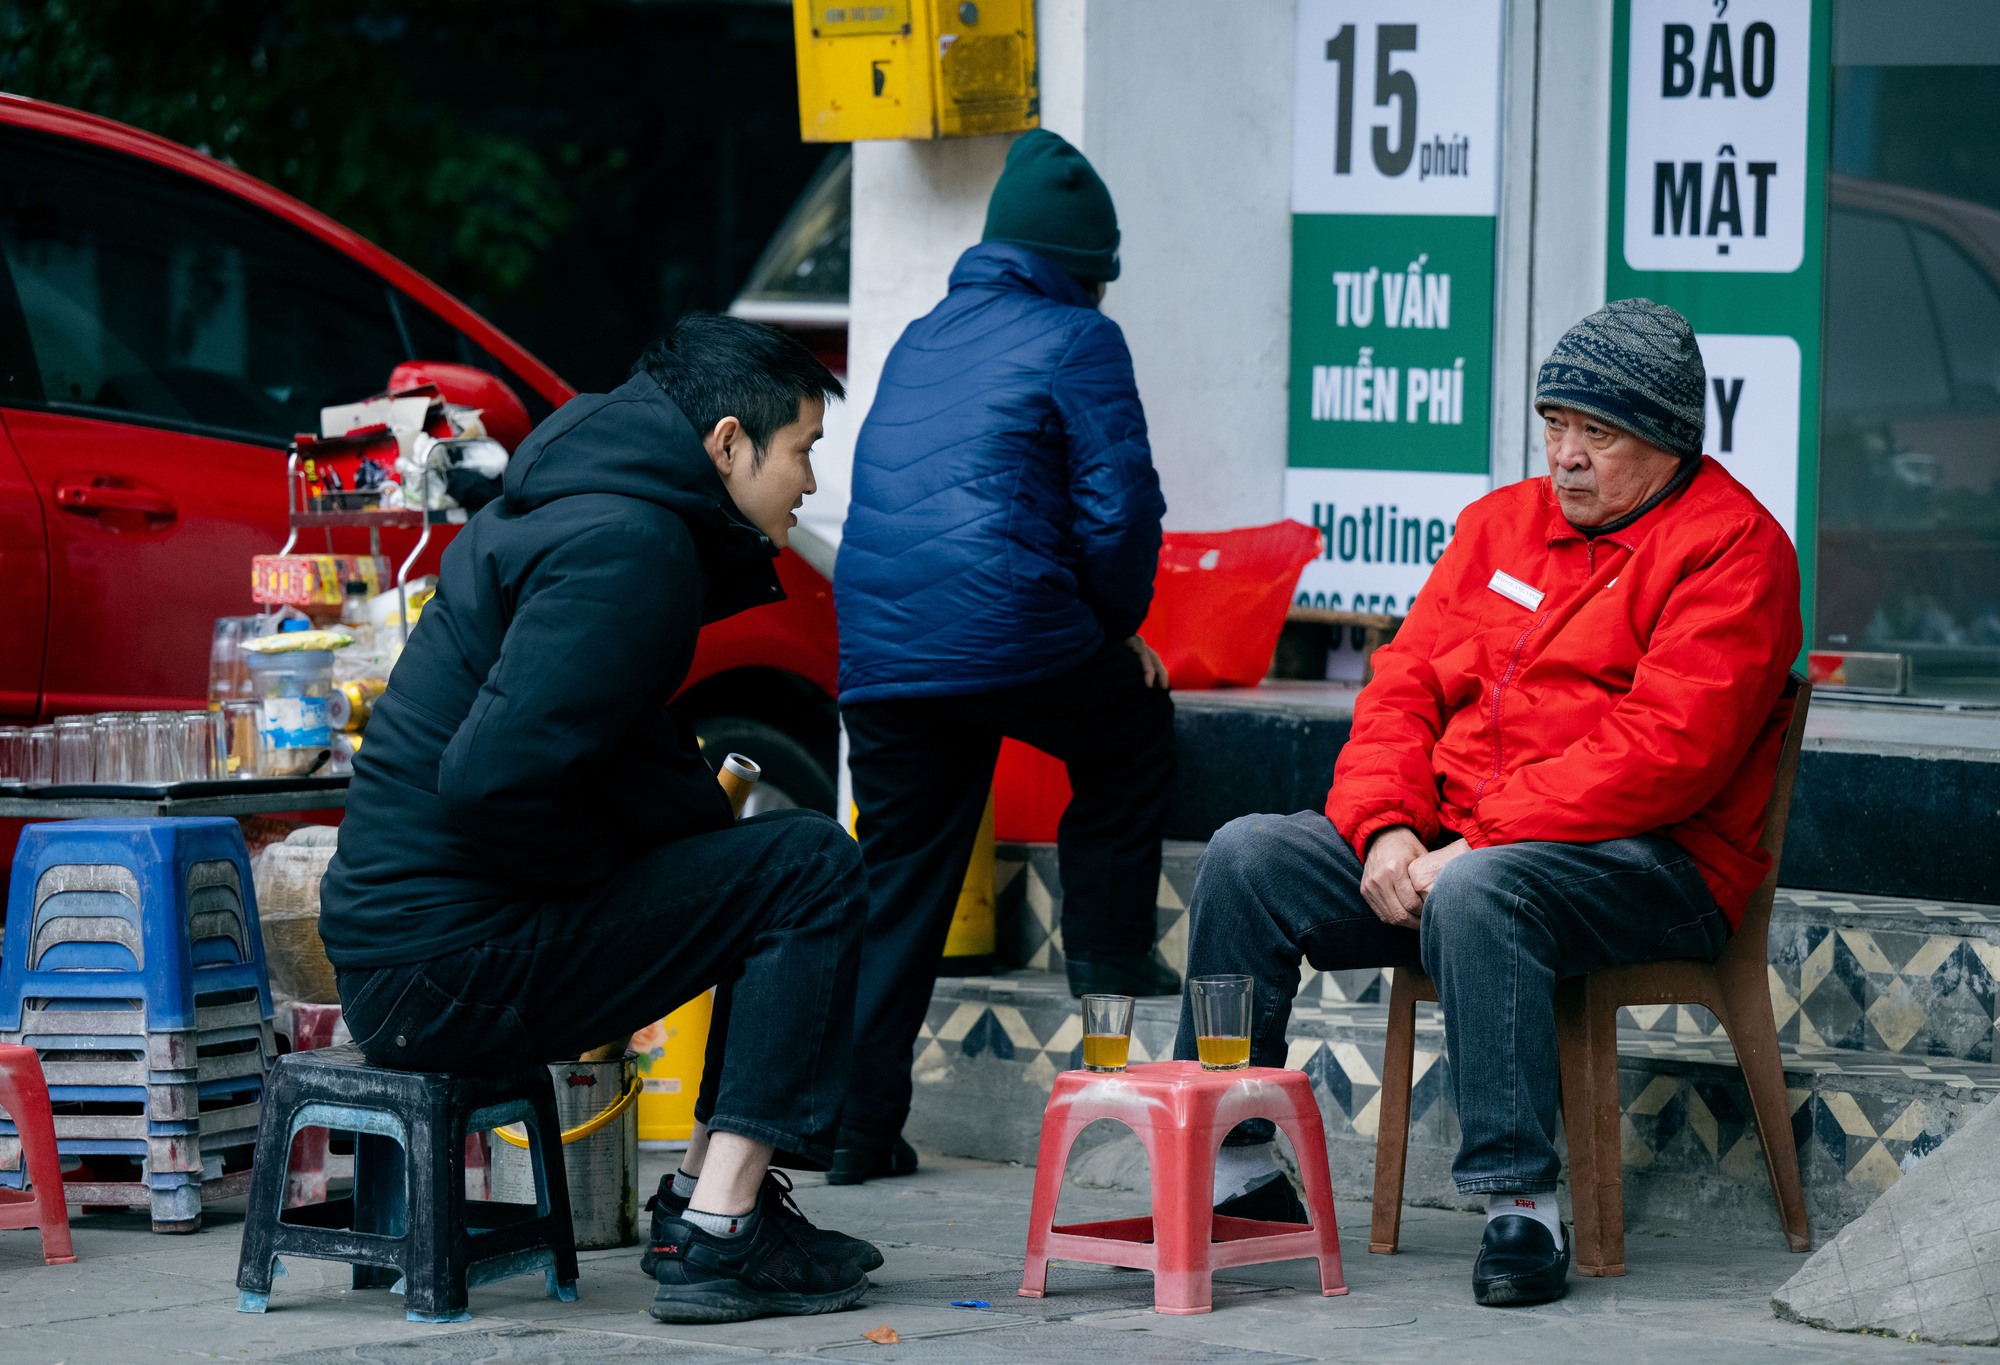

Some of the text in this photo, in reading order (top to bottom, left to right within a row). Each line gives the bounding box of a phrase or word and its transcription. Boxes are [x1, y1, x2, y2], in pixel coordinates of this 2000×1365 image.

[1661, 0, 1776, 98] BẢO
[1324, 23, 1470, 182] 15 phút
[1652, 144, 1777, 255] MẬT
[1332, 253, 1451, 330] TƯ VẤN
[1311, 346, 1466, 425] MIỄN PHÍ
[1710, 377, 1745, 453] Y
[1312, 502, 1457, 566] Hotline
